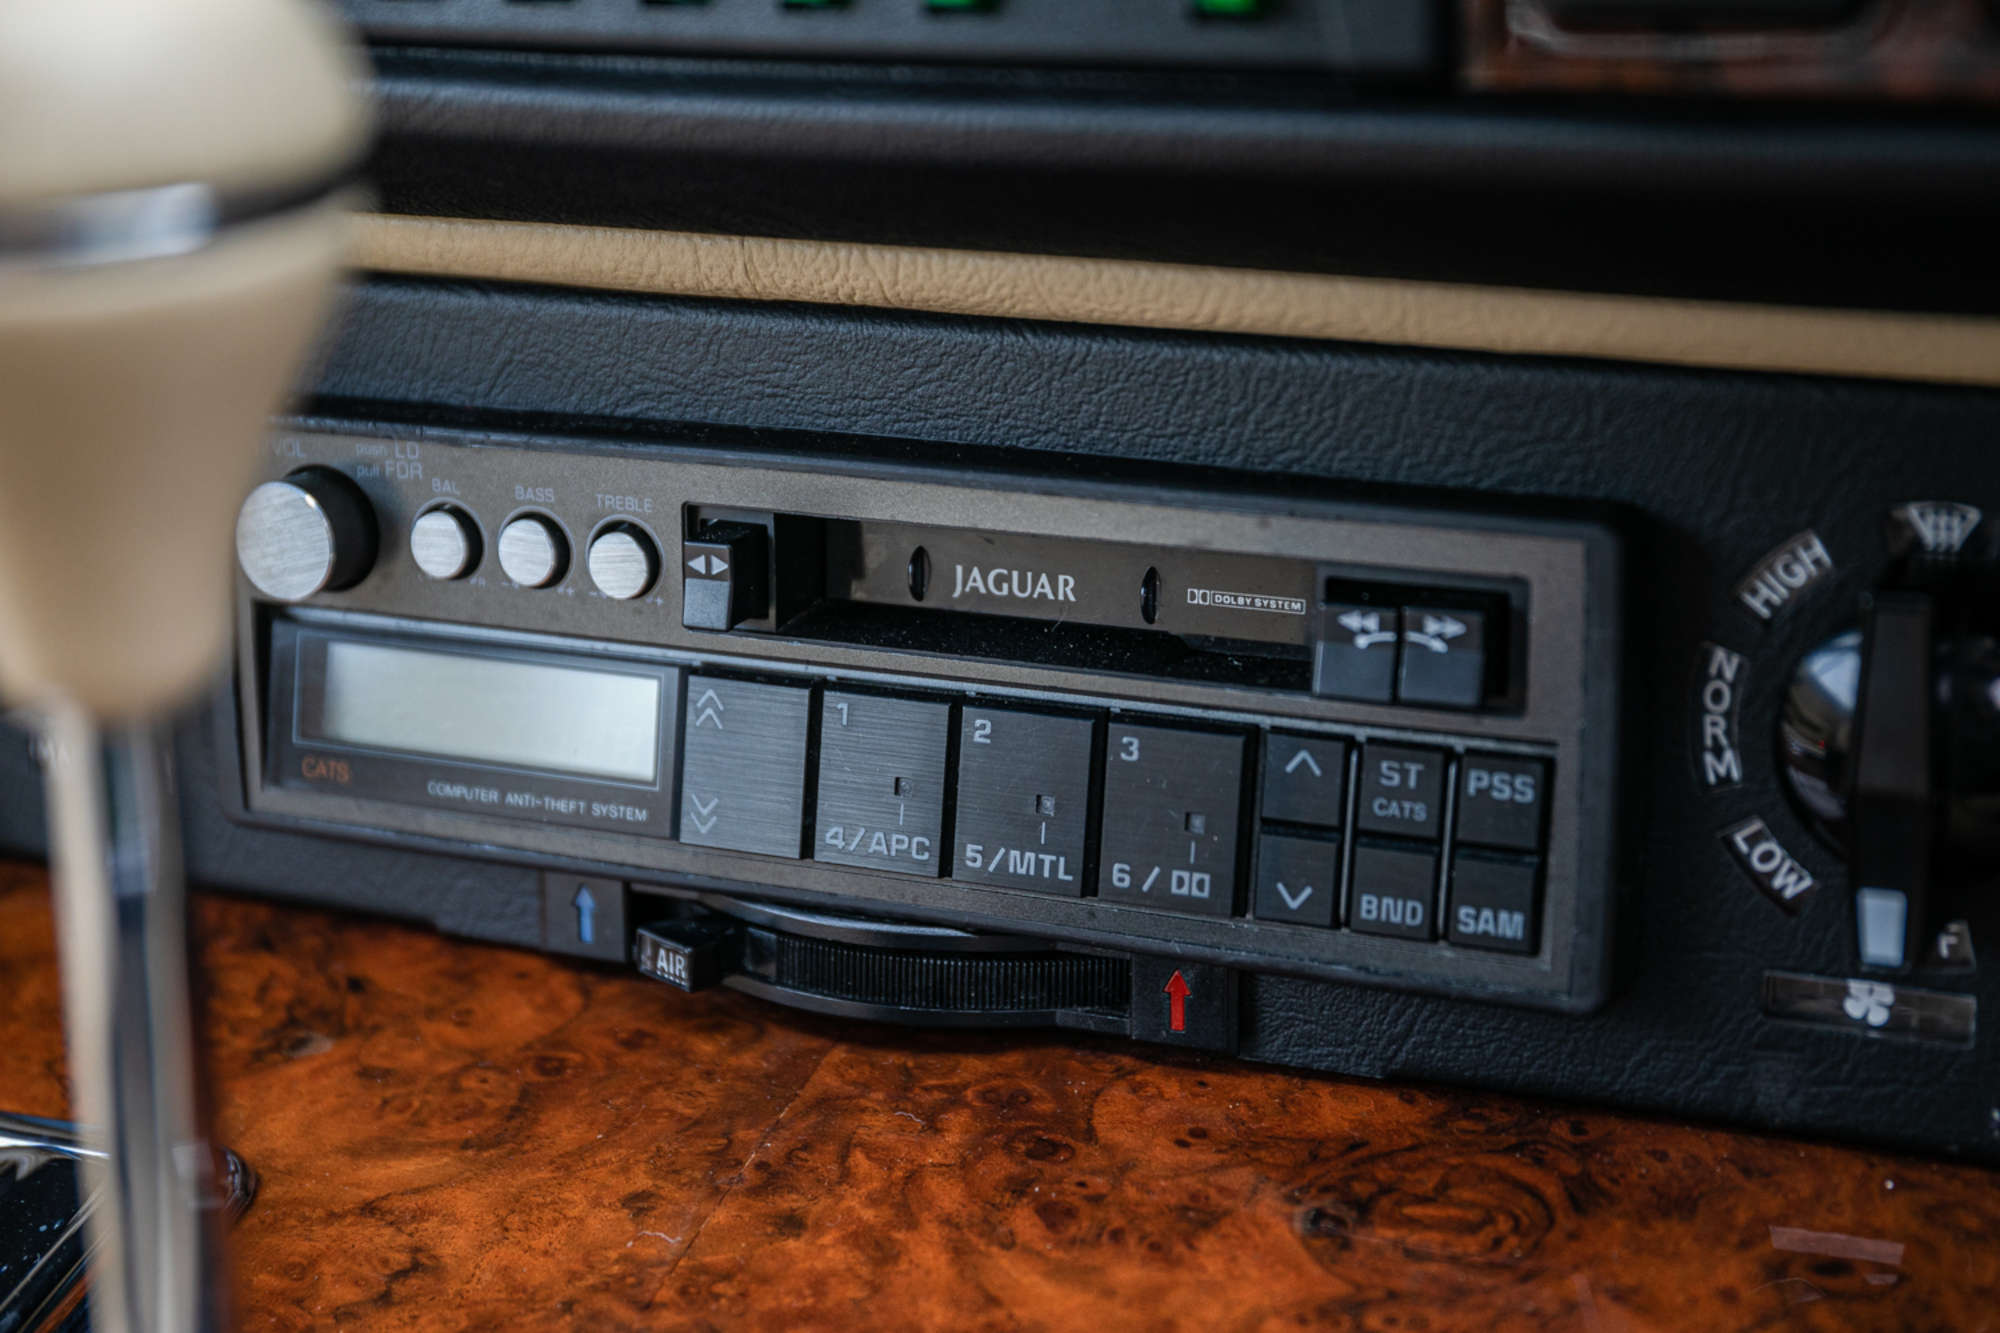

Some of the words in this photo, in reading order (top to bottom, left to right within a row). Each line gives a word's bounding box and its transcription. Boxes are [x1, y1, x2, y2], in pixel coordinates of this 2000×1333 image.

[431, 477, 461, 496] BAL
[514, 484, 555, 503] BASS
[595, 494, 654, 513] TREBLE
[952, 564, 1077, 602] JAGUAR
[1739, 531, 1833, 619] HIGH
[1214, 594, 1252, 606] DOLBY
[1254, 597, 1302, 611] SYSTEM
[836, 702, 849, 726] 1
[1703, 648, 1742, 786] NORM
[973, 718, 992, 744] 2
[1119, 736, 1140, 762] 3
[300, 755, 350, 784] CATS
[1379, 760, 1424, 789] ST
[1466, 768, 1536, 803] PSS
[427, 779, 499, 804] COMPUTER
[505, 792, 586, 815] ANTI-THEFT
[591, 802, 647, 823] SYSTEM
[1372, 797, 1428, 822] CATS
[824, 826, 930, 861] 4/APC
[1733, 817, 1814, 900] LOW
[965, 843, 1074, 881] 5/MTL
[1359, 894, 1424, 927] BND
[1457, 905, 1526, 940] SAM
[656, 946, 687, 979] AIR
